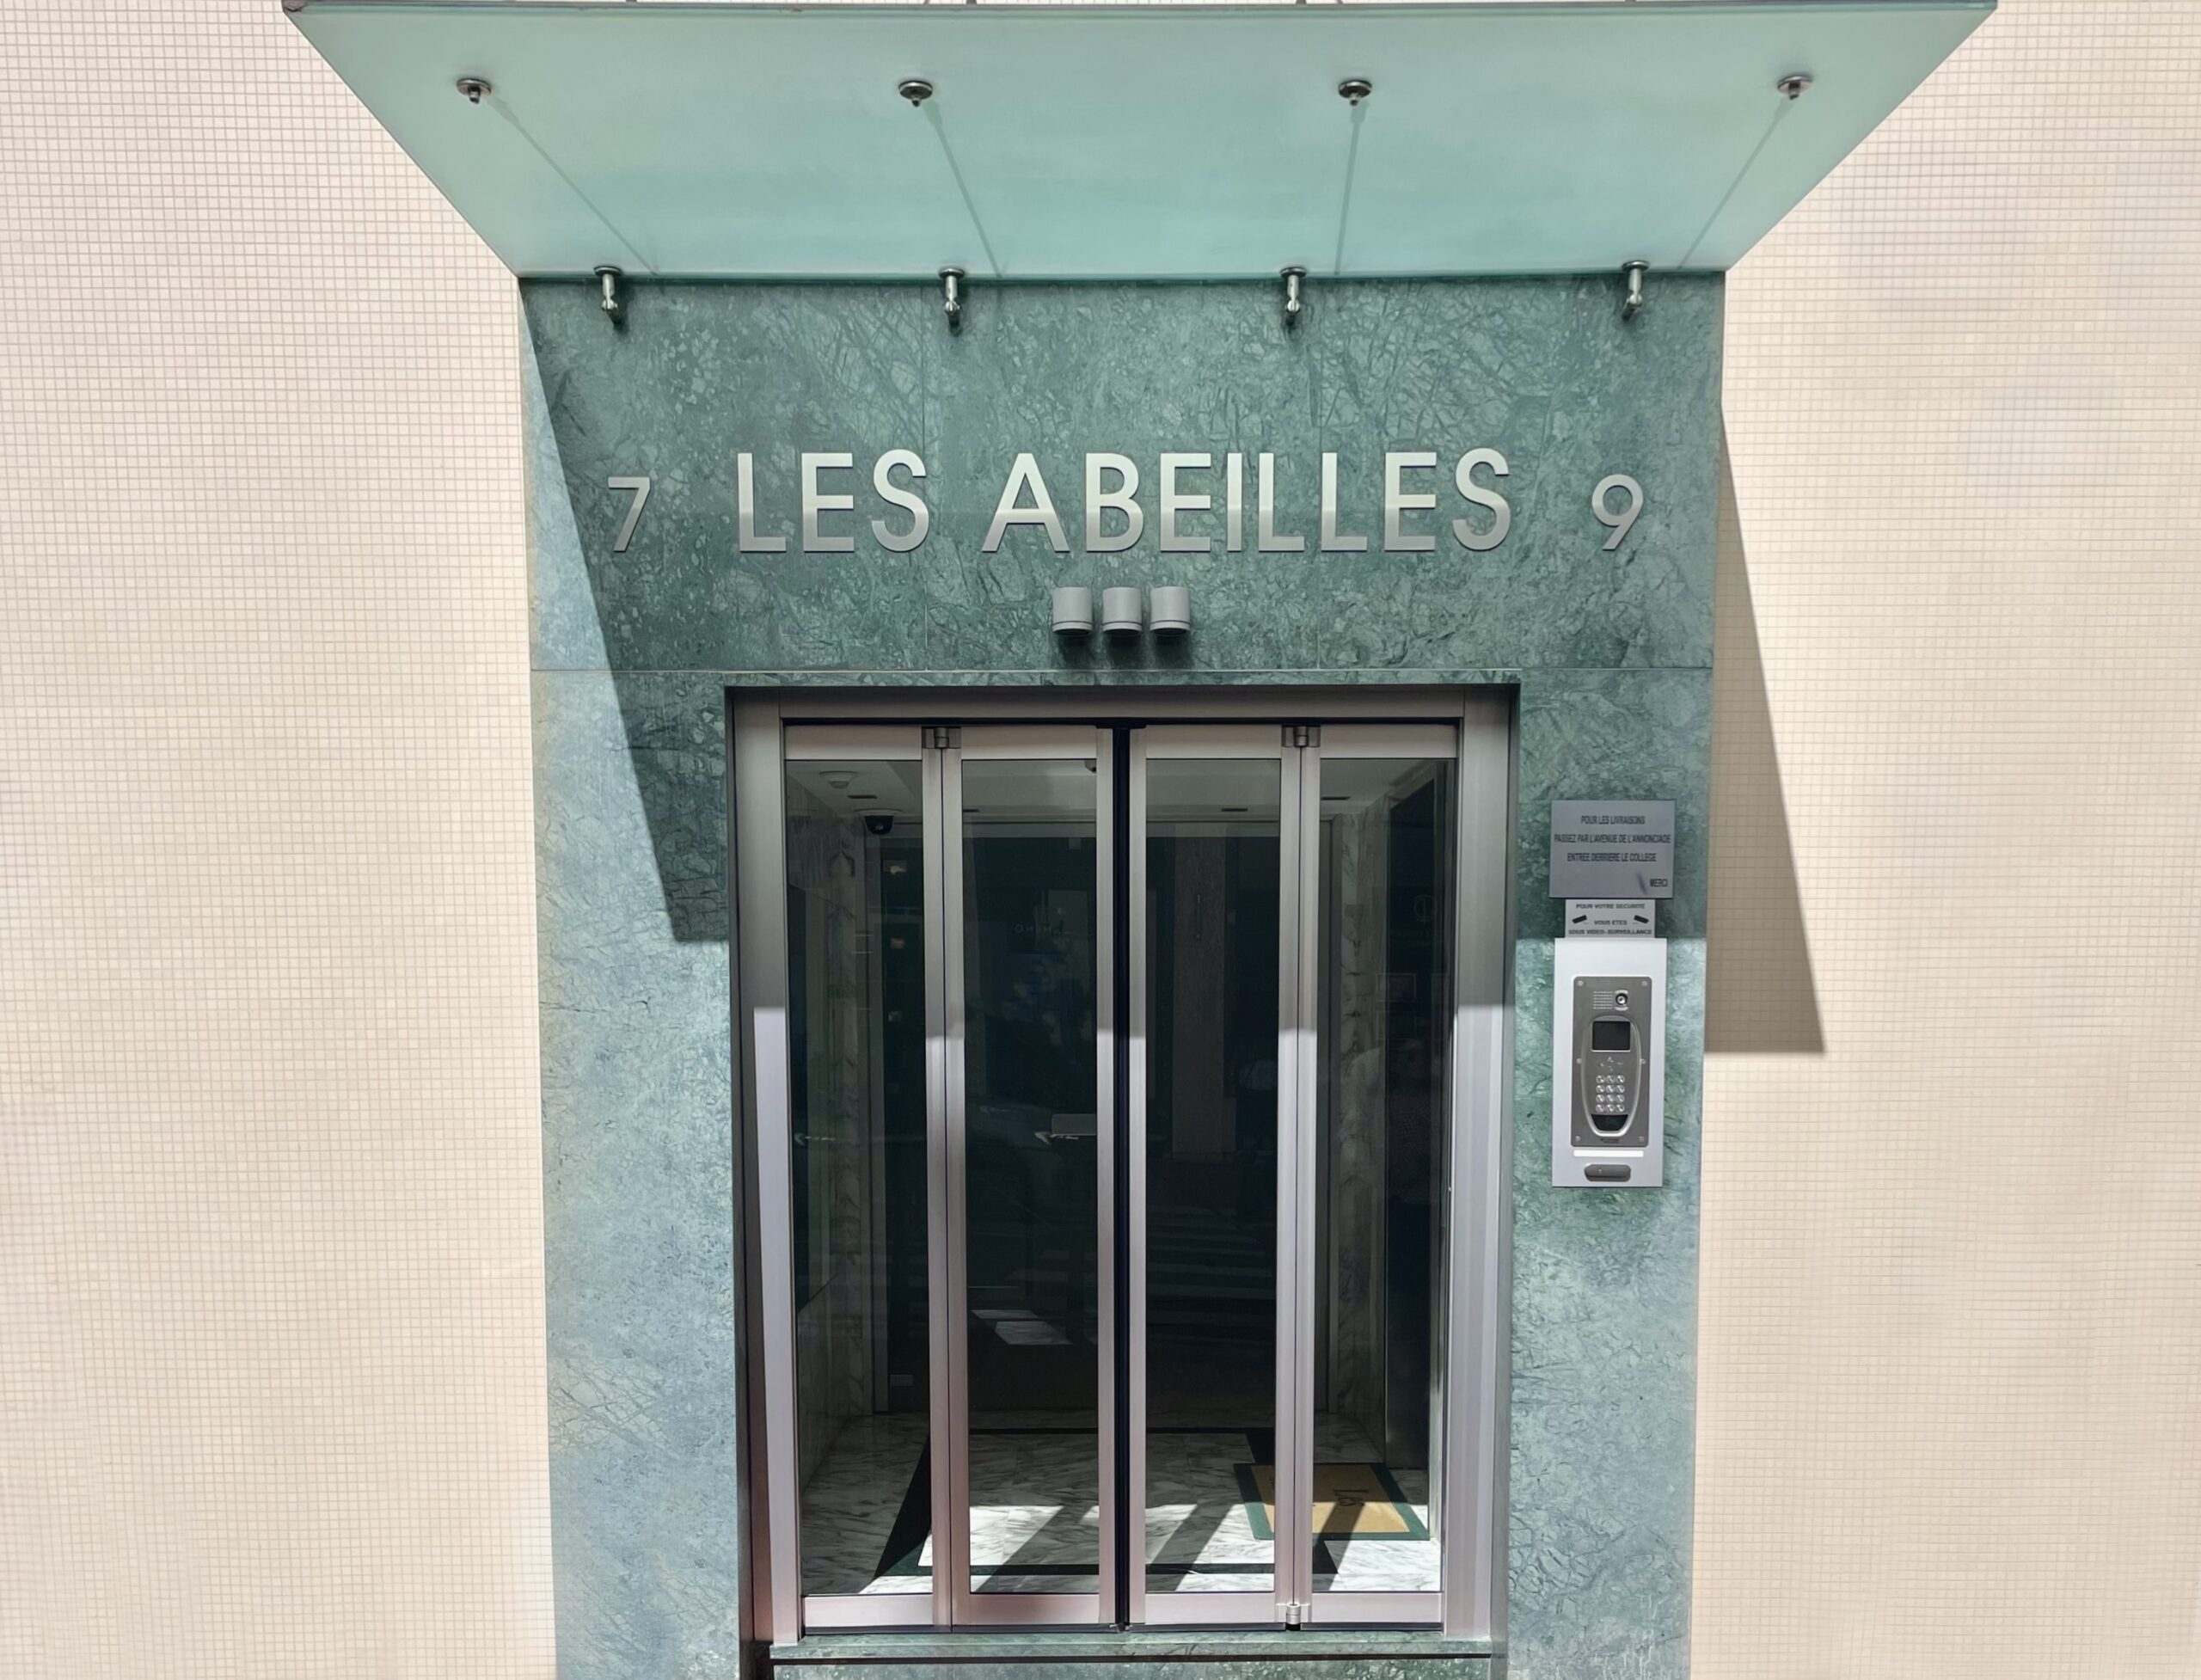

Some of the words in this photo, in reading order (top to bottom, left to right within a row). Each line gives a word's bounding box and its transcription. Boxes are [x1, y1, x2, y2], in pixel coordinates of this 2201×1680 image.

[608, 476, 650, 552] 7
[737, 449, 929, 553] LES
[982, 448, 1511, 553] ABEILLES
[1591, 474, 1644, 550] 9
[1581, 815, 1597, 825] POUR
[1599, 815, 1609, 825] LES
[1610, 815, 1646, 825] LIVRAISONS
[1554, 834, 1577, 843] PASSEZ
[1578, 834, 1589, 843] PAR
[1619, 834, 1627, 843] DE
[1622, 853, 1629, 861] LE
[1650, 879, 1668, 887] MERCI
